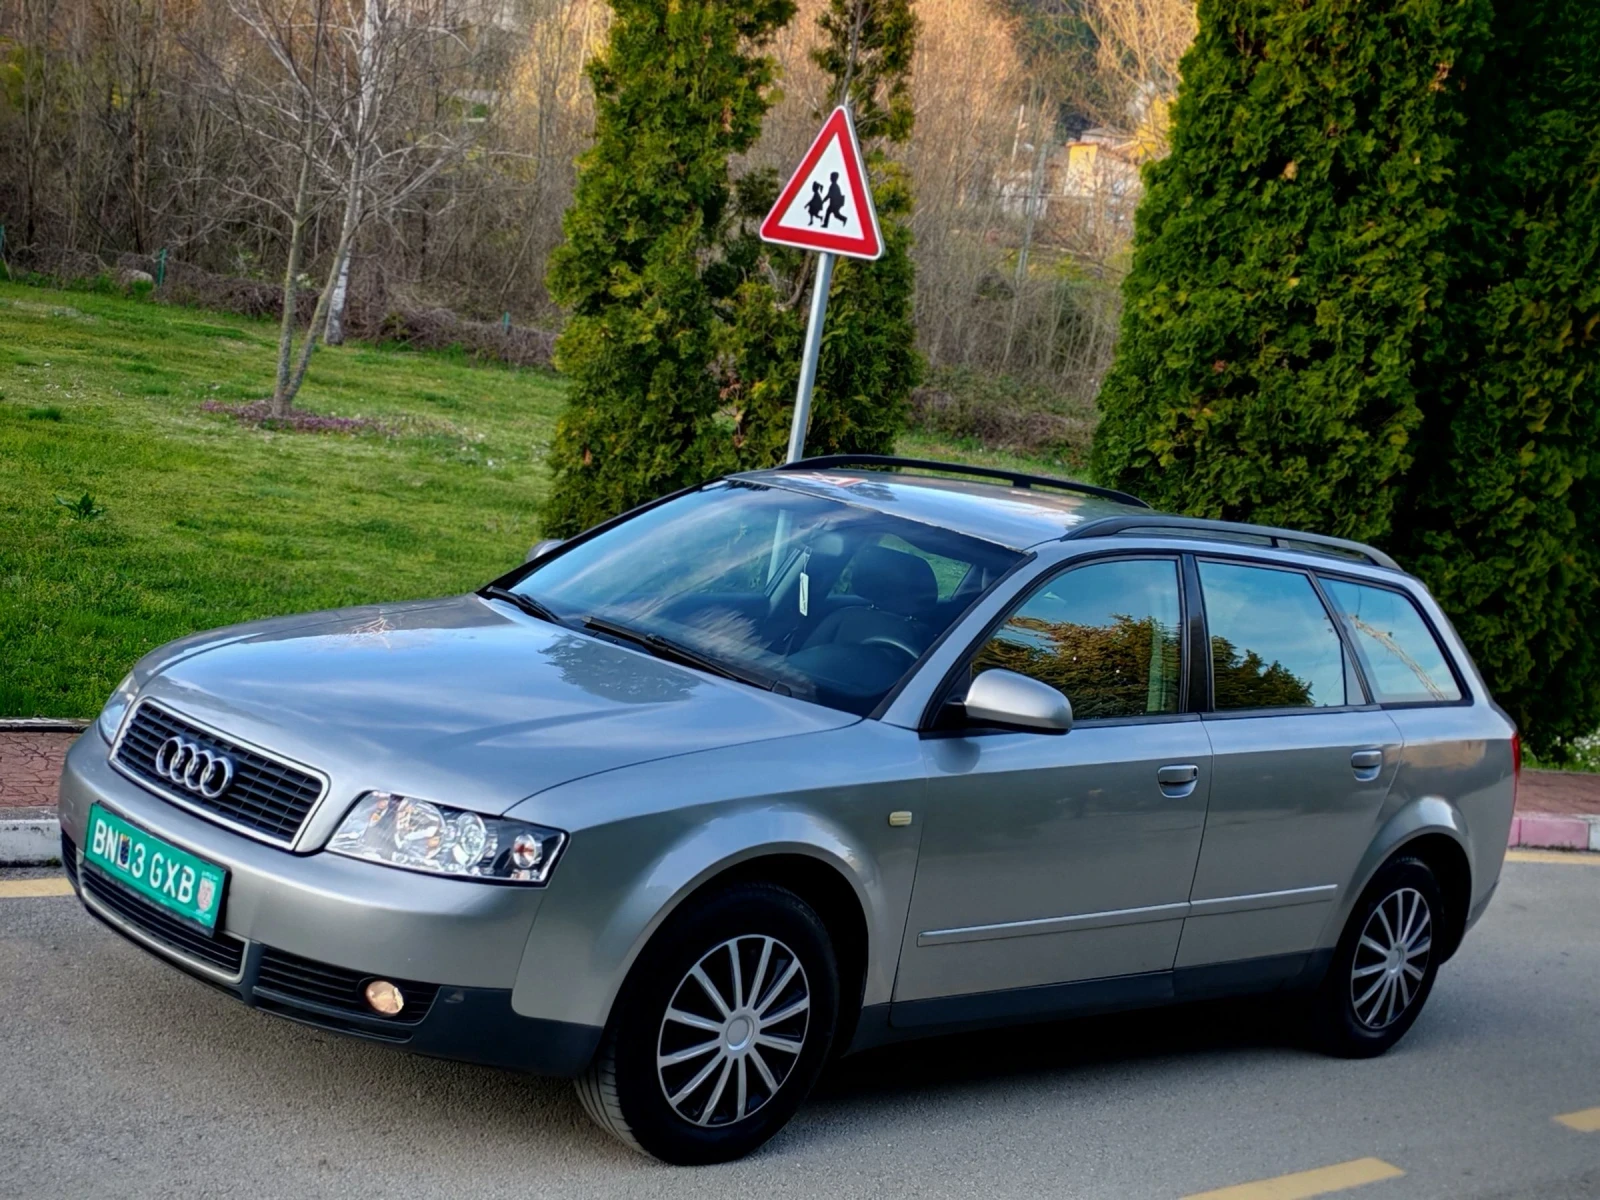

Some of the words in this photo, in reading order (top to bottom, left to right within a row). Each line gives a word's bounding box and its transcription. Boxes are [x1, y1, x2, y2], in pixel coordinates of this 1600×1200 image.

[93, 818, 118, 863] BN
[131, 843, 146, 878] 3
[150, 852, 195, 903] GXB
